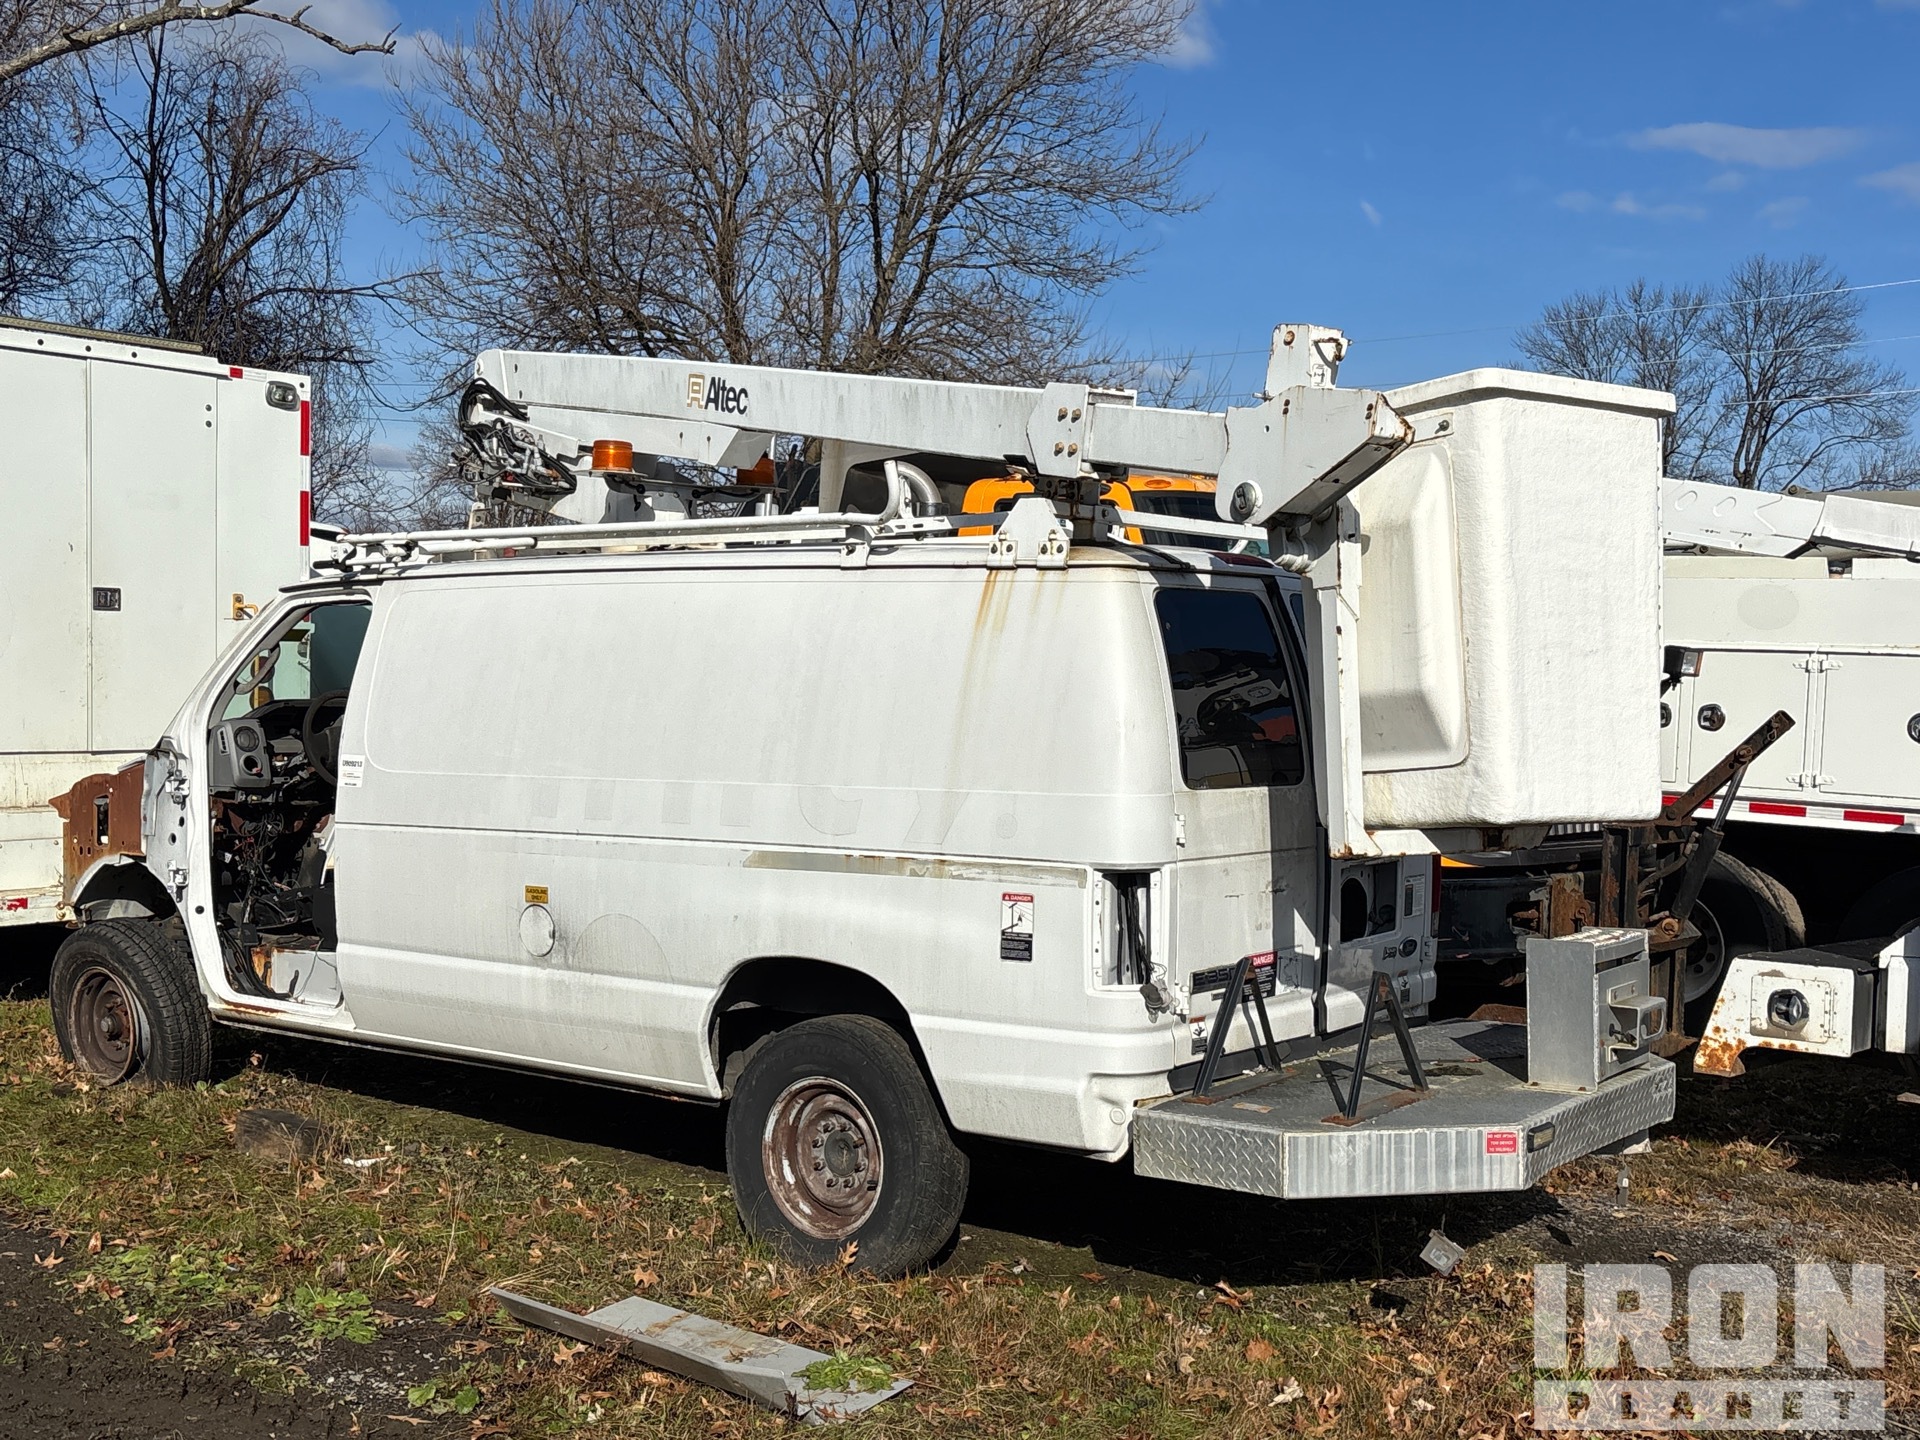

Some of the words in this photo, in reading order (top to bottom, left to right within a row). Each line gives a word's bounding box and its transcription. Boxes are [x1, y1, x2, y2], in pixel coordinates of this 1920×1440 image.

[704, 376, 748, 415] Altec
[1010, 894, 1032, 902] DANGER
[1252, 953, 1275, 966] DANGER
